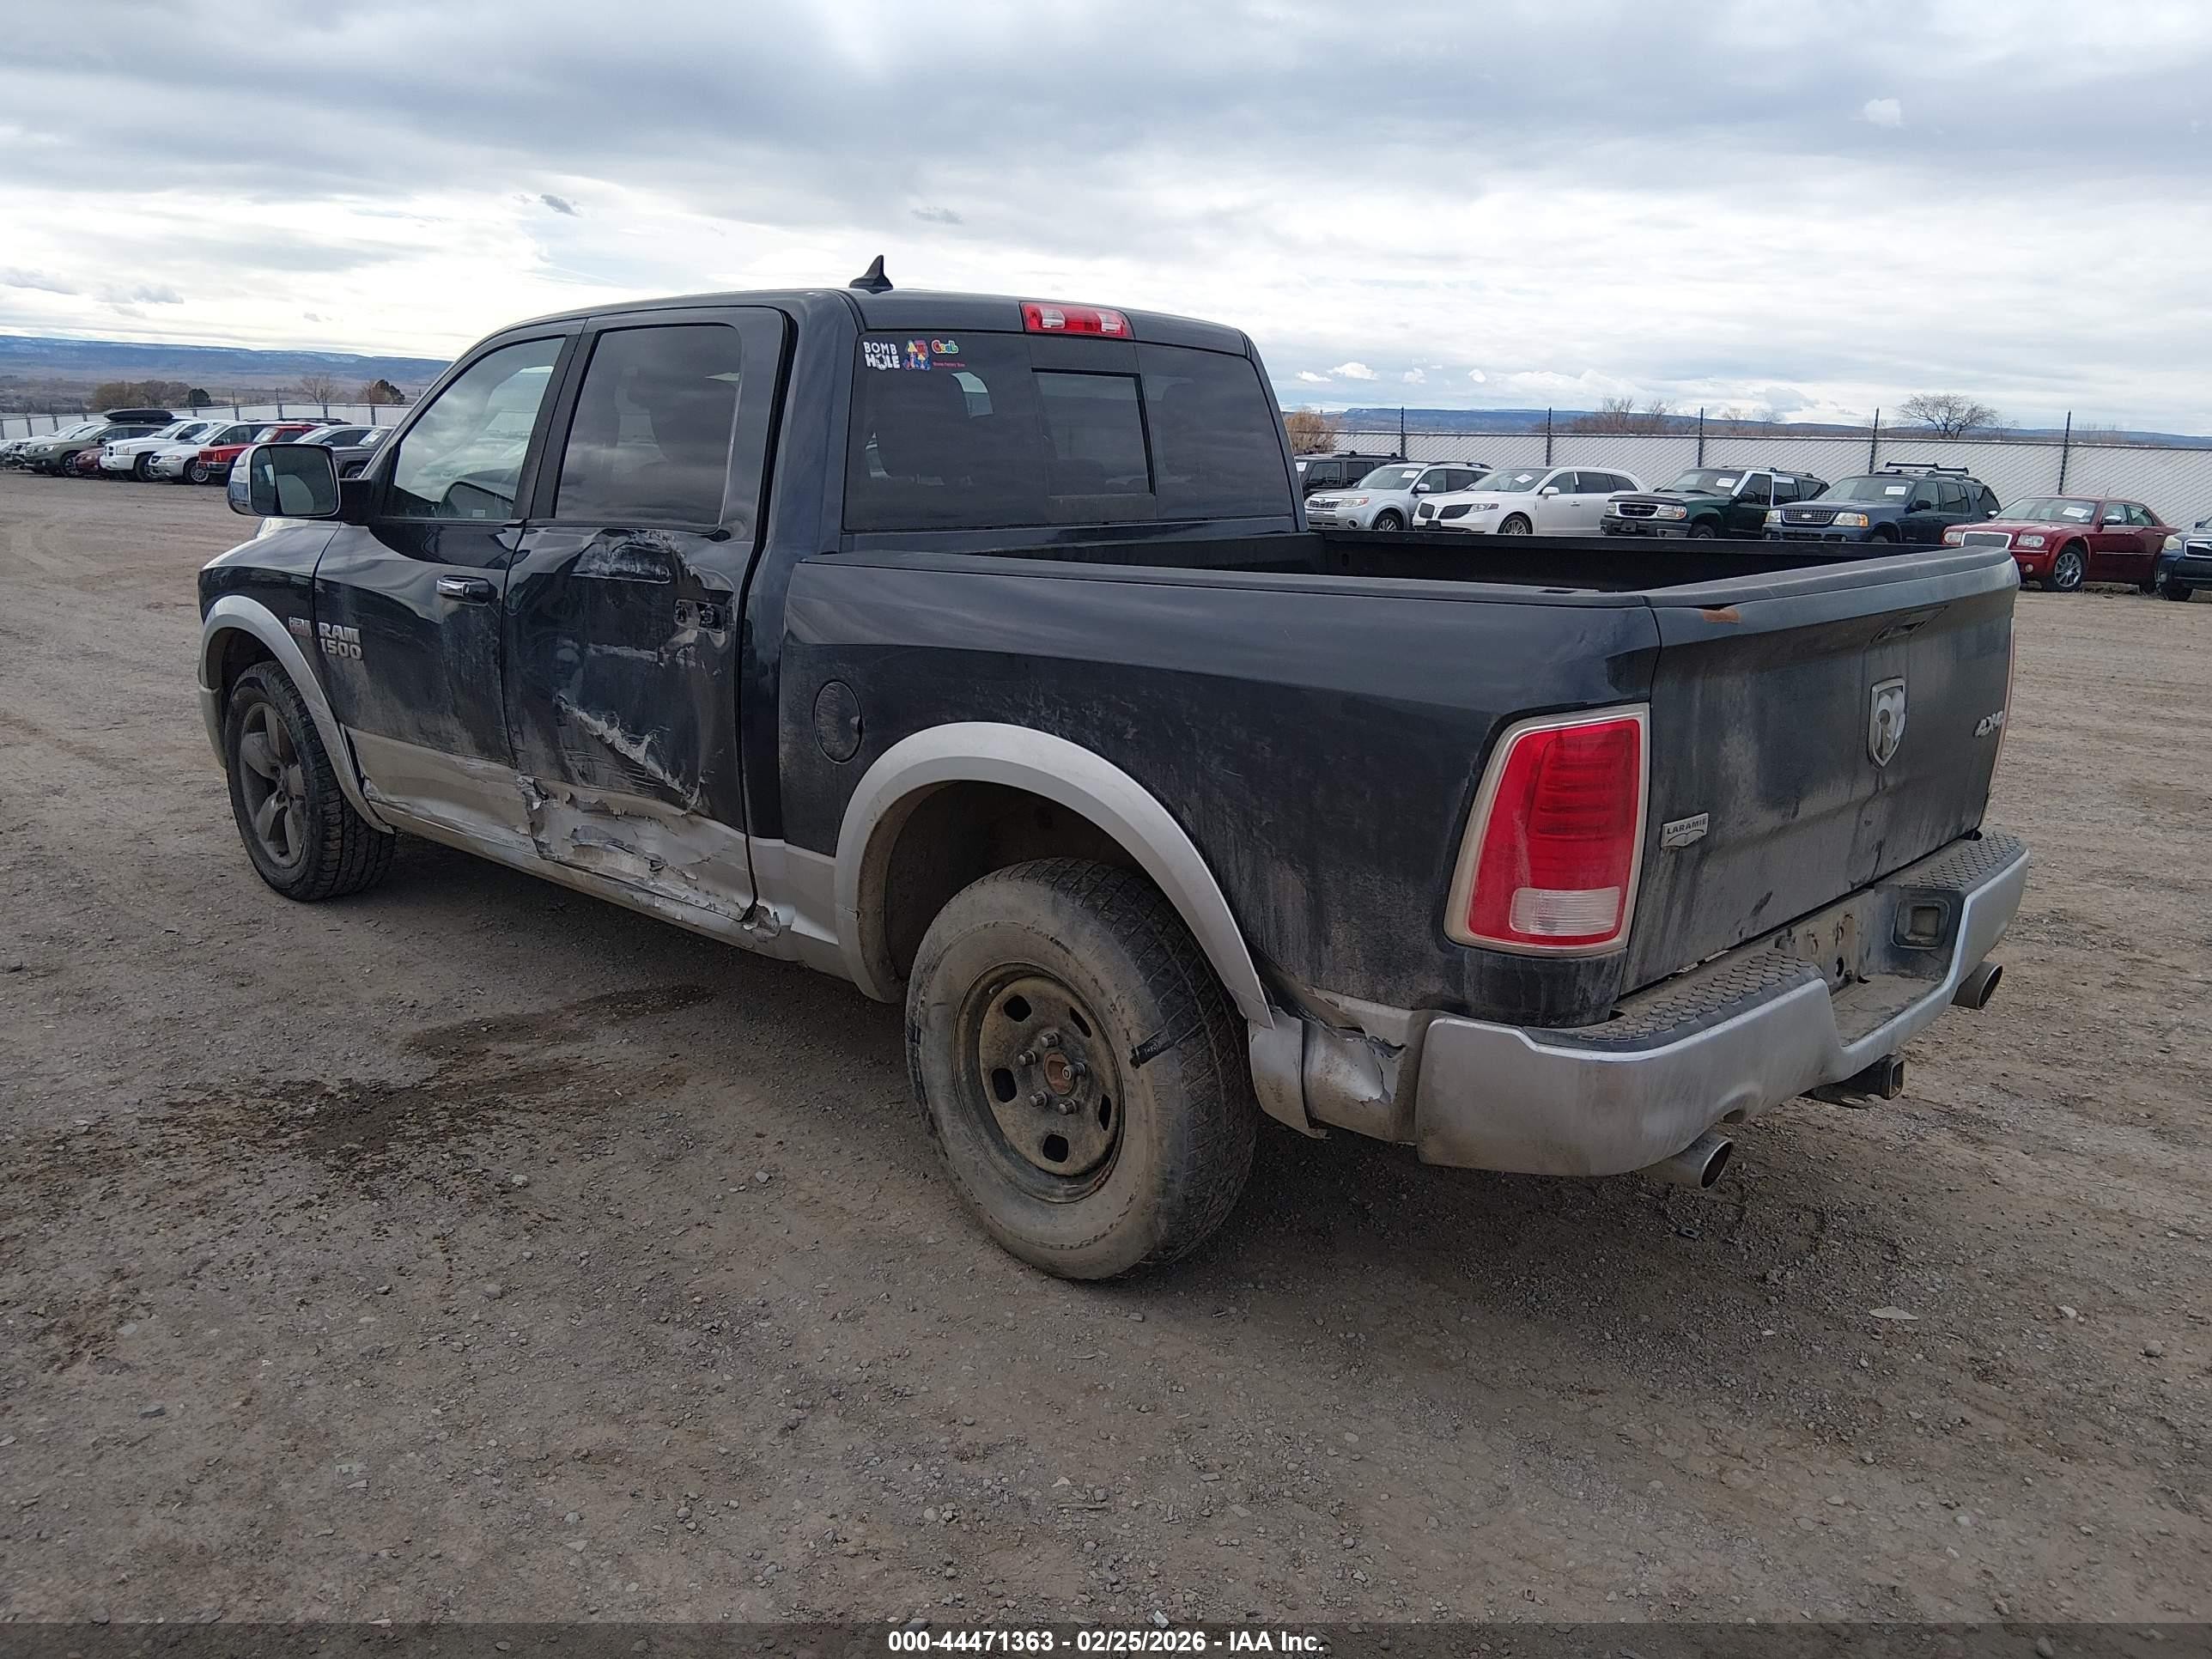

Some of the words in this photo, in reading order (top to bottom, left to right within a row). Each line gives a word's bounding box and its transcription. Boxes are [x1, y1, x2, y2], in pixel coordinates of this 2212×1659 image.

[863, 342, 897, 355] BOMB
[865, 353, 900, 370] HOLE
[319, 622, 361, 644] RAM
[319, 638, 362, 659] 1500
[1667, 817, 1707, 835] LARAMIE
